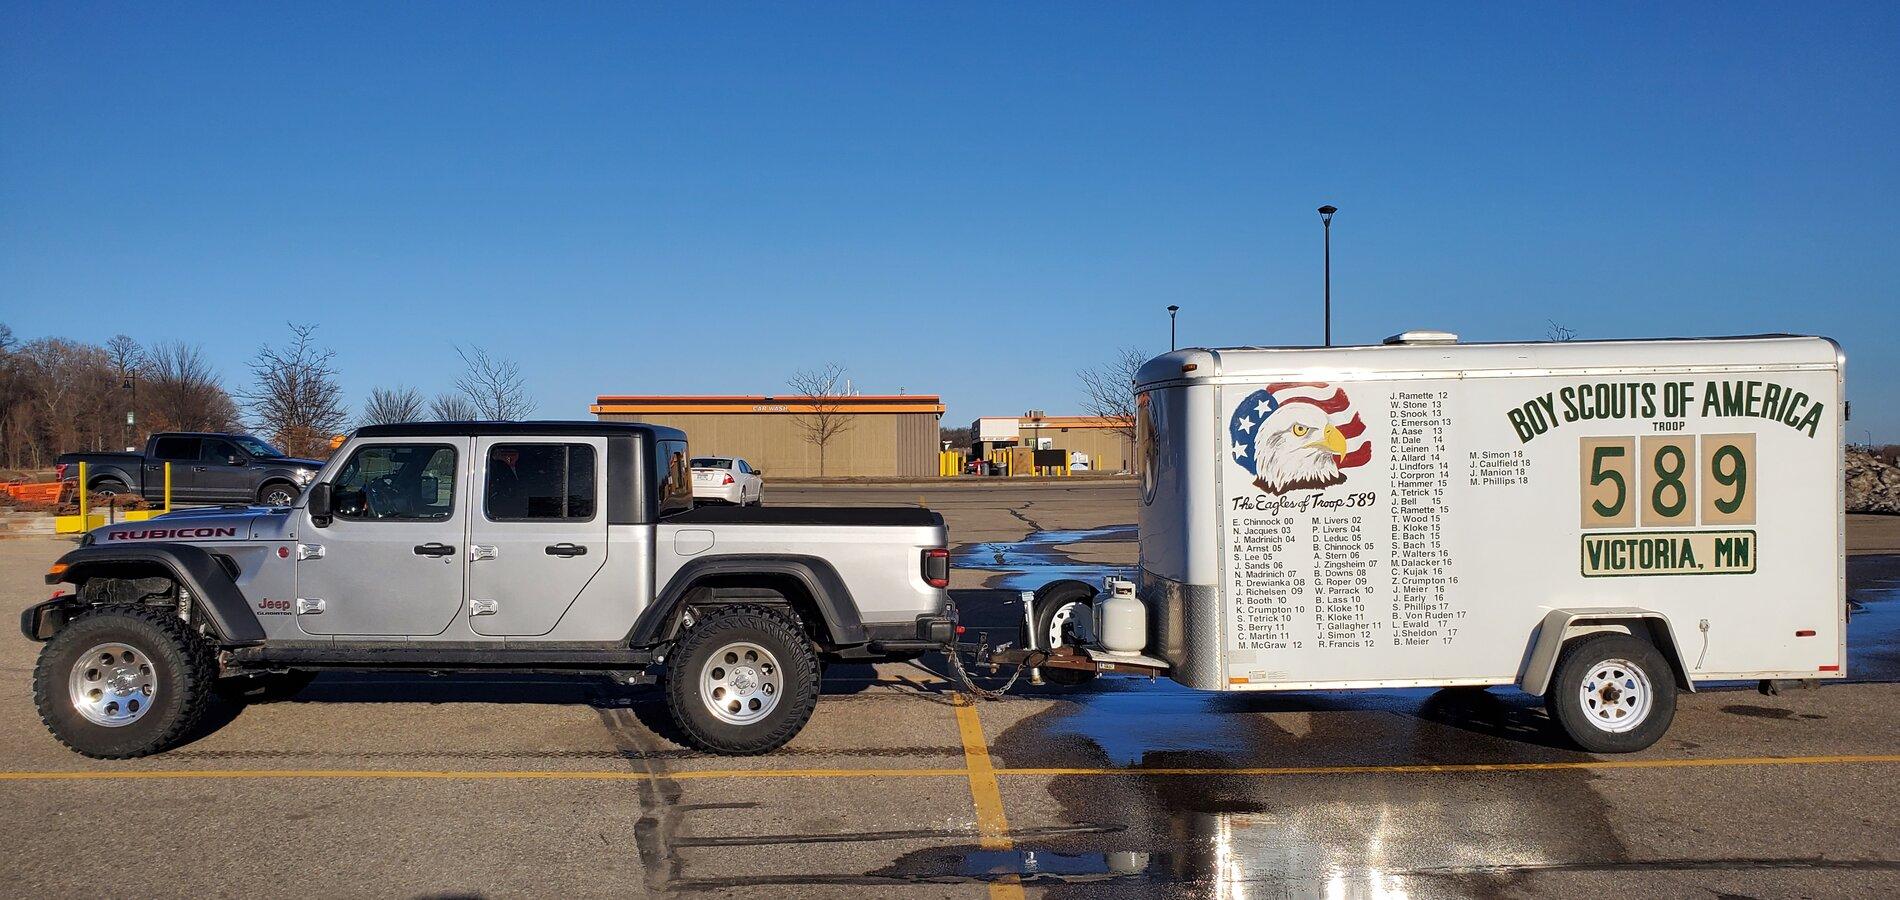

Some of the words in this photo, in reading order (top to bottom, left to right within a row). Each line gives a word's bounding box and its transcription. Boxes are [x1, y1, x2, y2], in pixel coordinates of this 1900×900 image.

[1390, 401, 1401, 409] W.
[1402, 401, 1428, 409] Stone
[1431, 400, 1442, 409] 13
[1506, 392, 1560, 444] BOY
[1560, 382, 1656, 423] SCOUTS
[1664, 381, 1694, 418] OF
[1701, 380, 1824, 439] AMERICA
[1652, 421, 1685, 432] TROOP
[1469, 451, 1480, 460] M.
[1481, 451, 1511, 459] Simon
[1512, 450, 1524, 458] 18
[1469, 460, 1478, 469] J.
[1479, 459, 1519, 468] Caulfield
[1520, 458, 1531, 467] 18
[1469, 469, 1478, 478] J.
[1480, 469, 1513, 477] Manion
[1515, 467, 1526, 476] 18
[1469, 477, 1481, 486] M.
[1482, 477, 1516, 487] Phillips
[1518, 476, 1529, 485] 18
[1232, 496, 1254, 511] The
[1255, 494, 1298, 516] Eagles
[1297, 494, 1311, 513] of
[1311, 493, 1345, 512] Troop
[1345, 491, 1376, 508] 589
[1232, 518, 1241, 527] E.
[1243, 518, 1281, 526] Chinnock
[1283, 517, 1294, 525] 00
[1311, 517, 1322, 525] M.
[1324, 517, 1349, 525] Livers
[1351, 516, 1362, 524] 02
[1391, 515, 1400, 524] T.
[1402, 515, 1428, 523] Wood
[1430, 514, 1441, 523] 15
[1233, 527, 1242, 535] N.
[1244, 527, 1279, 536] Jacques
[1280, 526, 1292, 535] 03
[1312, 525, 1320, 534] P.
[1322, 526, 1348, 534] Livers
[1350, 525, 1361, 533] 04
[1391, 524, 1401, 532] B.
[1403, 524, 1429, 532] Kloke
[1430, 523, 1441, 532] 15
[108, 527, 237, 541] RUBICON
[1312, 534, 1321, 543] D.
[1323, 535, 1349, 543] Leduc
[1351, 533, 1362, 542] 05
[1391, 532, 1400, 540] E.
[1402, 532, 1426, 540] Bach
[1430, 532, 1441, 540] 15
[1233, 536, 1241, 544] J.
[1243, 535, 1283, 544] Madrinich
[1285, 535, 1296, 543] 04
[1233, 544, 1244, 553] M.
[1272, 544, 1283, 552] 05
[1312, 543, 1322, 552] B.
[1324, 543, 1362, 551] Chinnock
[1364, 542, 1375, 550] 05
[1391, 541, 1401, 550] S.
[1402, 541, 1426, 550] Bach
[1430, 540, 1441, 549] 15
[1233, 553, 1242, 561] S.
[1244, 553, 1260, 561] Lee
[1262, 552, 1273, 561] 05
[1313, 552, 1323, 560] A.
[1325, 552, 1347, 560] Stern
[1349, 551, 1360, 559] 06
[1391, 550, 1400, 558] P.
[1402, 550, 1436, 558] Walters
[1438, 549, 1449, 557] 16
[1586, 538, 1704, 570] VICTORIA,
[1714, 537, 1749, 568] MN
[1234, 562, 1242, 570] J.
[1244, 562, 1271, 570] Sands
[1273, 561, 1284, 570] 06
[1313, 561, 1321, 569] J.
[1323, 560, 1366, 570] Zingsheim
[1368, 559, 1378, 568] 07
[1234, 571, 1243, 579] N.
[1245, 570, 1285, 578] Madrinich
[1287, 569, 1297, 578] 07
[1313, 569, 1323, 578] B.
[1325, 569, 1354, 577] Downs
[1356, 568, 1367, 577] 08
[1391, 567, 1401, 576] C.
[1403, 567, 1429, 577] Kujak
[1432, 567, 1443, 575] 16
[1235, 579, 1244, 588] R.
[1246, 579, 1291, 587] Drewianka
[1293, 578, 1306, 587] 08
[1314, 577, 1324, 586] G.
[1326, 578, 1352, 587] Roper
[1354, 577, 1368, 586] 09
[1235, 588, 1243, 597] J.
[1245, 588, 1287, 596] Richelsen
[1290, 587, 1304, 595] 09
[1314, 587, 1326, 595] W.
[1328, 587, 1360, 595] Parrack
[1364, 586, 1374, 594] 10
[1392, 585, 1401, 594] J.
[1403, 585, 1429, 593] Meier
[1434, 585, 1445, 593] 16
[1235, 597, 1245, 605] R.
[1246, 597, 1273, 605] Booth
[1277, 596, 1287, 604] 10
[1315, 596, 1325, 604] B.
[1327, 596, 1348, 604] Lass
[1350, 595, 1361, 603] 10
[1393, 594, 1401, 603] J.
[1403, 594, 1427, 603] Early
[1434, 593, 1444, 602] 16
[258, 597, 291, 611] Jeep
[1315, 605, 1325, 613] D.
[1327, 604, 1353, 613] Kloke
[1354, 604, 1365, 612] 10
[1392, 603, 1401, 611] S.
[1404, 602, 1437, 612] Phillips
[1438, 602, 1449, 610] 17
[1236, 606, 1246, 614] K.
[1247, 606, 1292, 615] Crumpton
[1294, 605, 1305, 614] 10
[1236, 614, 1246, 623] S.
[1247, 614, 1279, 622] Tetrick
[1281, 614, 1292, 622] 10
[1315, 613, 1325, 622] R.
[1327, 613, 1353, 621] Kloke
[1355, 613, 1364, 621] 11
[1237, 623, 1247, 632] S.
[1248, 623, 1273, 633] Berry
[1275, 623, 1285, 631] 11
[1316, 622, 1325, 631] T.
[1327, 622, 1370, 631] Gallagher
[1372, 621, 1382, 629] 11
[1392, 621, 1400, 629] L.
[1402, 620, 1429, 628] Ewald
[1437, 619, 1448, 628] 17
[1237, 632, 1247, 641] C.
[1249, 632, 1277, 640] Martin
[1280, 632, 1289, 640] 11
[1317, 631, 1325, 640] J.
[1327, 631, 1356, 639] Simon
[1360, 630, 1371, 639] 12
[1238, 641, 1249, 650] M.
[1251, 641, 1287, 649] McGraw
[1293, 641, 1303, 649] 12
